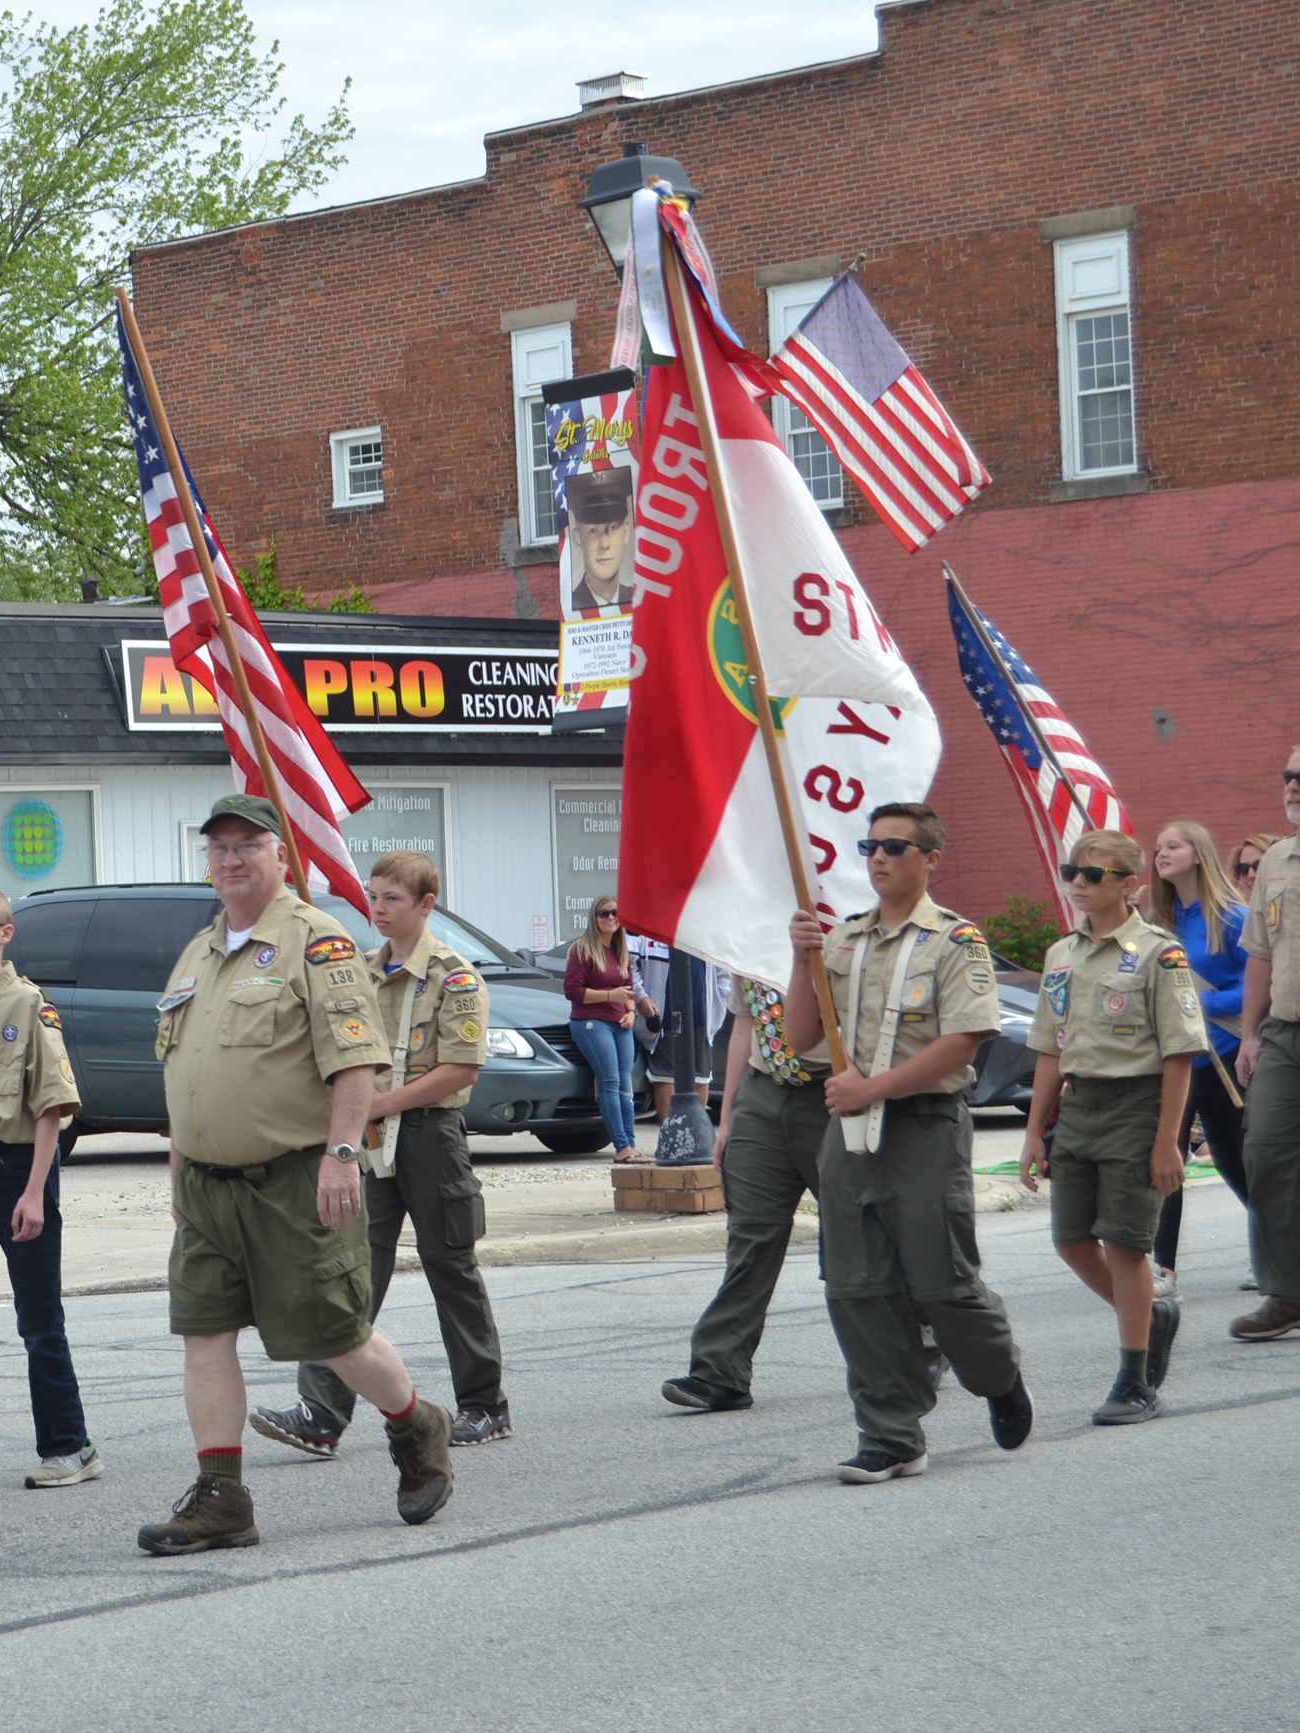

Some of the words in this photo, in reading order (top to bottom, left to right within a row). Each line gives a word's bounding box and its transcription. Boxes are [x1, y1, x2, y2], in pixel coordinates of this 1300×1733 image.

[555, 418, 581, 452] St.
[583, 415, 634, 446] Marys
[572, 632, 612, 646] KENNETH
[613, 631, 621, 639] R.
[611, 659, 626, 668] Navy
[572, 669, 600, 680] Operation
[600, 667, 619, 676] Desert
[303, 659, 446, 718] PRO
[378, 795, 431, 813] Mitigation
[559, 799, 616, 815] Commercial
[583, 817, 622, 834] Cleanin
[348, 836, 369, 853] Fire
[372, 836, 435, 852] Restoration
[572, 856, 595, 871] Odor
[966, 945, 988, 959] 360
[329, 969, 355, 985] 138
[455, 998, 476, 1012] 360
